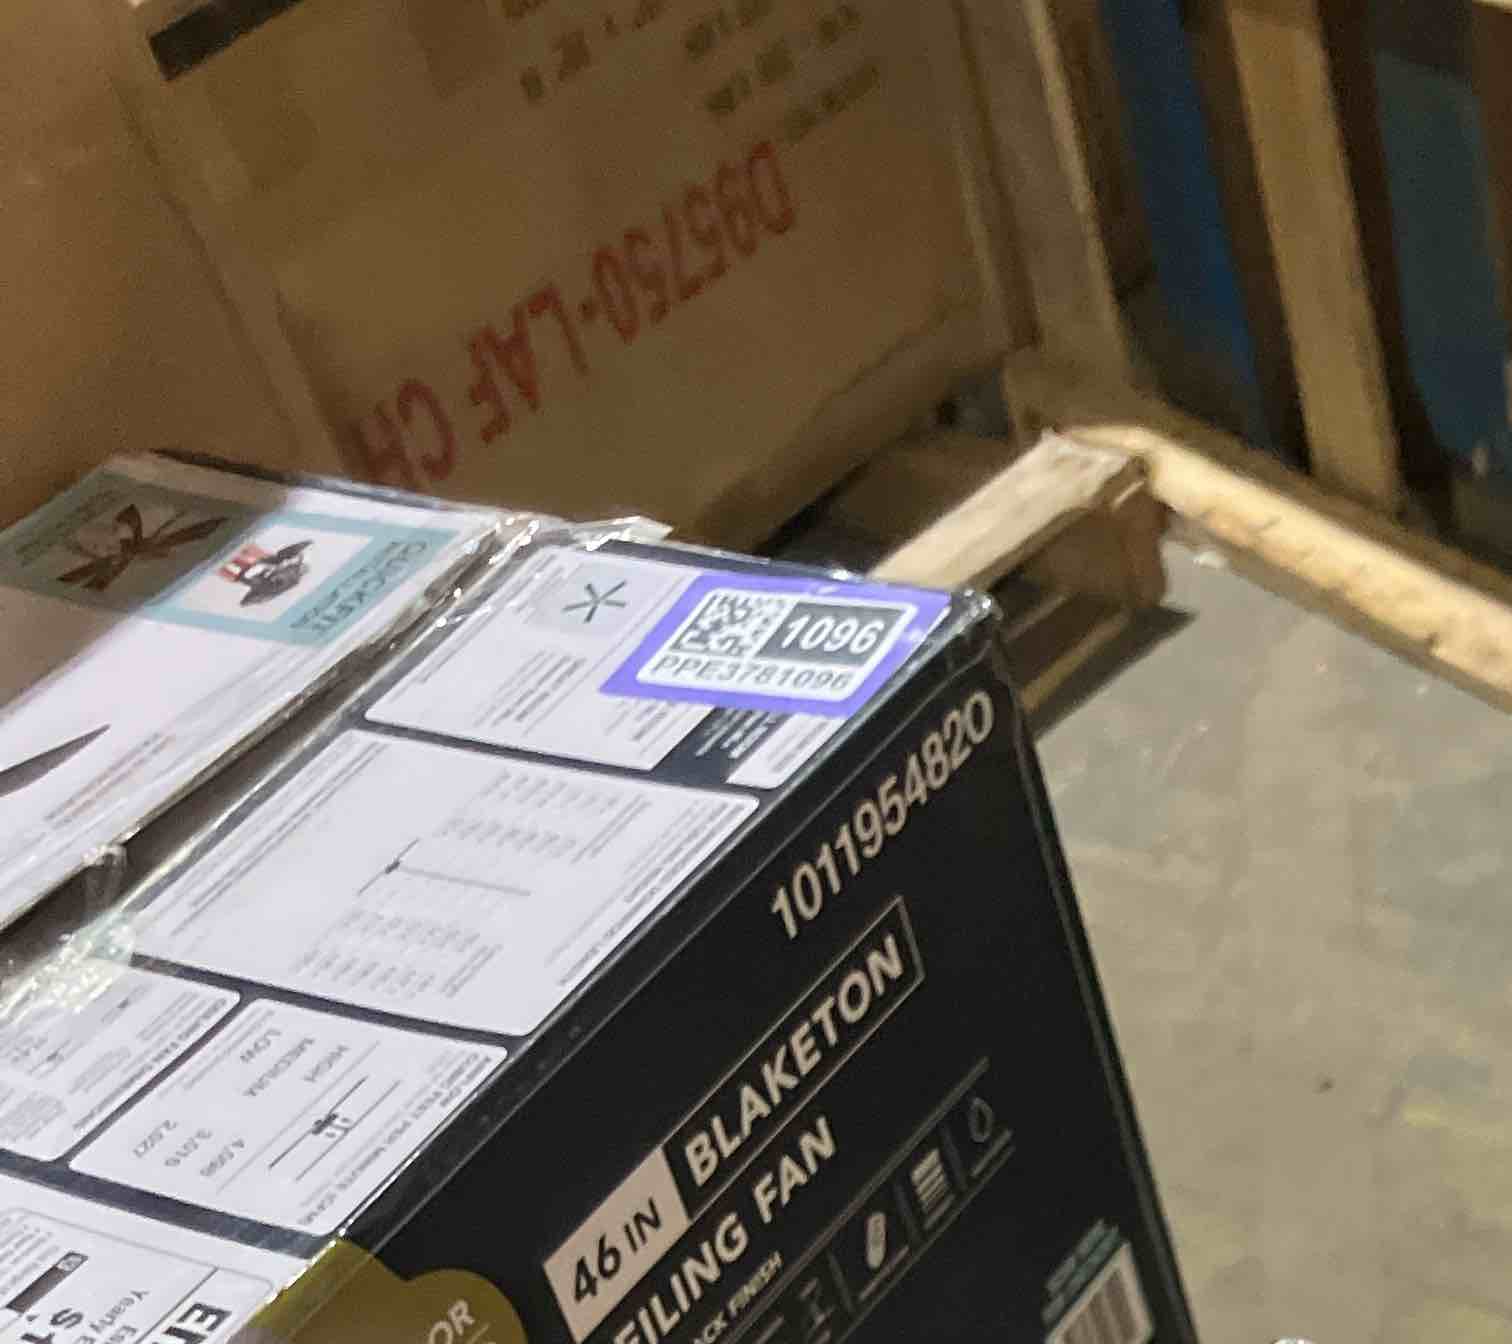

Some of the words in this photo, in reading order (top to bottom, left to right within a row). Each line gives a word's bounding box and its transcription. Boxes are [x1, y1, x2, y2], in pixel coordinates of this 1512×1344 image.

[781, 614, 883, 656] 1096
[651, 652, 853, 692] PPE3781096
[769, 690, 996, 942] 1011954820
[232, 1026, 287, 1066] LOW
[238, 1035, 320, 1100] MEDIUM
[298, 1042, 355, 1084] HIGH
[571, 1238, 621, 1307] 46
[623, 1197, 664, 1252] IN
[684, 935, 906, 1187] BLAKETON
[753, 1115, 837, 1226] FAN
[89, 1289, 149, 1333] Yearly
